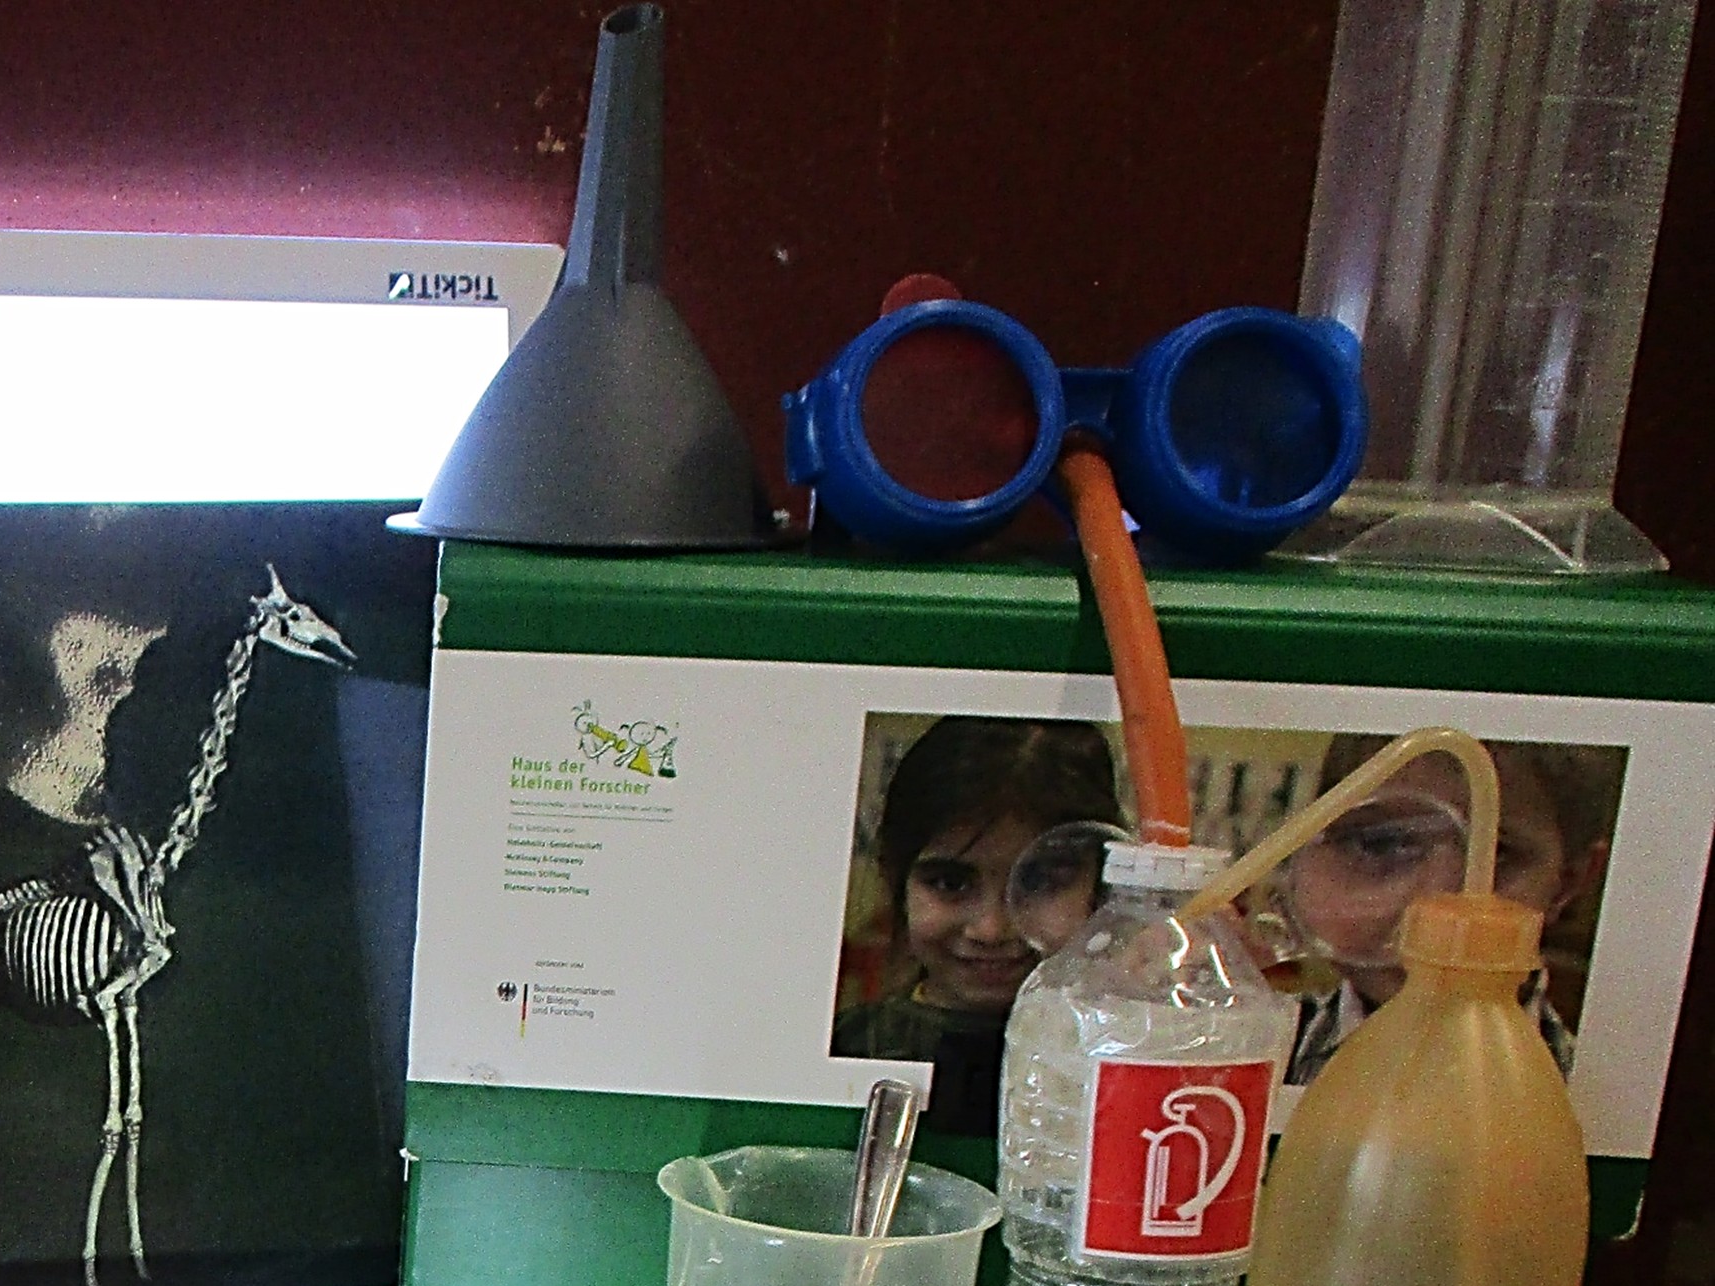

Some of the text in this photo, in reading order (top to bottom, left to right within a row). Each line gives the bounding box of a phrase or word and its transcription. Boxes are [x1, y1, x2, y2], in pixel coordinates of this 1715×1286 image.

[416, 272, 499, 301] TickiT
[511, 755, 586, 774] Haus der
[509, 774, 651, 796] kleinen Forscher
